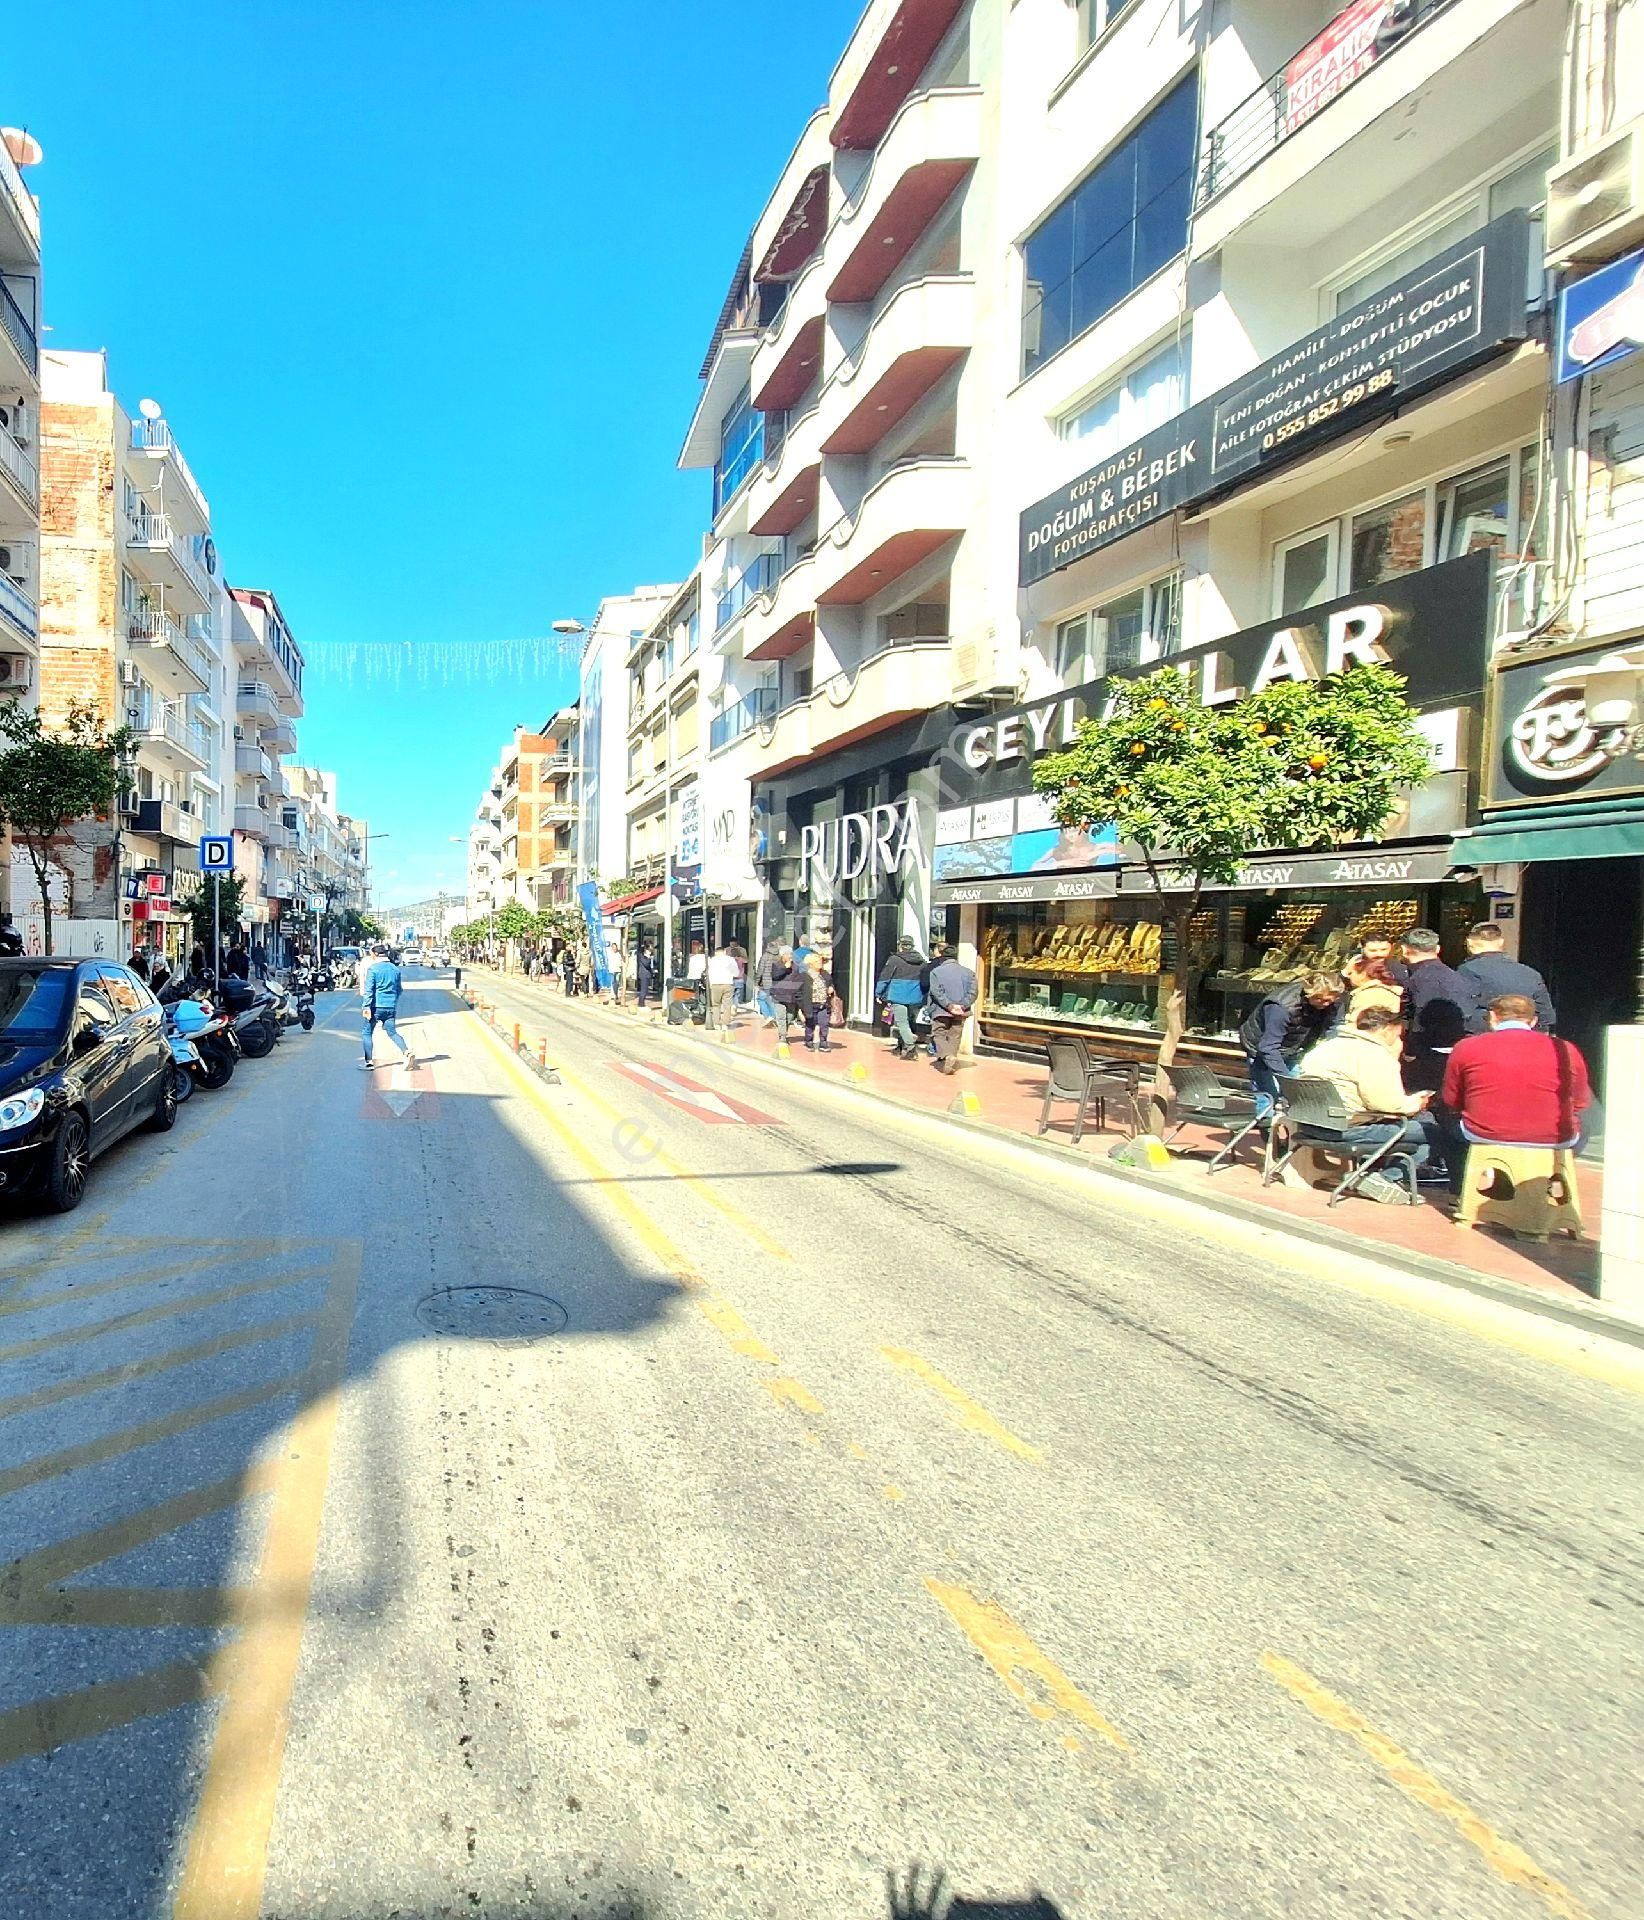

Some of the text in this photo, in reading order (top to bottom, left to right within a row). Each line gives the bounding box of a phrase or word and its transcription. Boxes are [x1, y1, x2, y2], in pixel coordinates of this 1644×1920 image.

[1290, 19, 1376, 112] KİRALIK
[1222, 401, 1252, 428] YENİ
[1255, 373, 1306, 411] DOĞAN
[1408, 279, 1472, 325] ÇOCUK
[1271, 336, 1327, 378] HAMİLE
[1340, 291, 1404, 337] DOĞUM
[1219, 305, 1472, 454] AİLE FOTOĞRAF ÇEKİM STÜDYOSU
[1263, 368, 1393, 449] 0 555 852 99 88
[1028, 439, 1196, 553] DOĞUM & BEBEK
[1069, 447, 1144, 502] KUŞADASI
[1054, 490, 1160, 559] FOTOĞRAFÇISI
[963, 604, 1393, 769] CEYLLAR
[151, 877, 162, 889] E
[208, 843, 225, 863] D
[800, 796, 931, 891] PUDRA
[1330, 859, 1412, 880] ATASAY
[950, 882, 1095, 900] ATASAY ATASAY ATASAY
